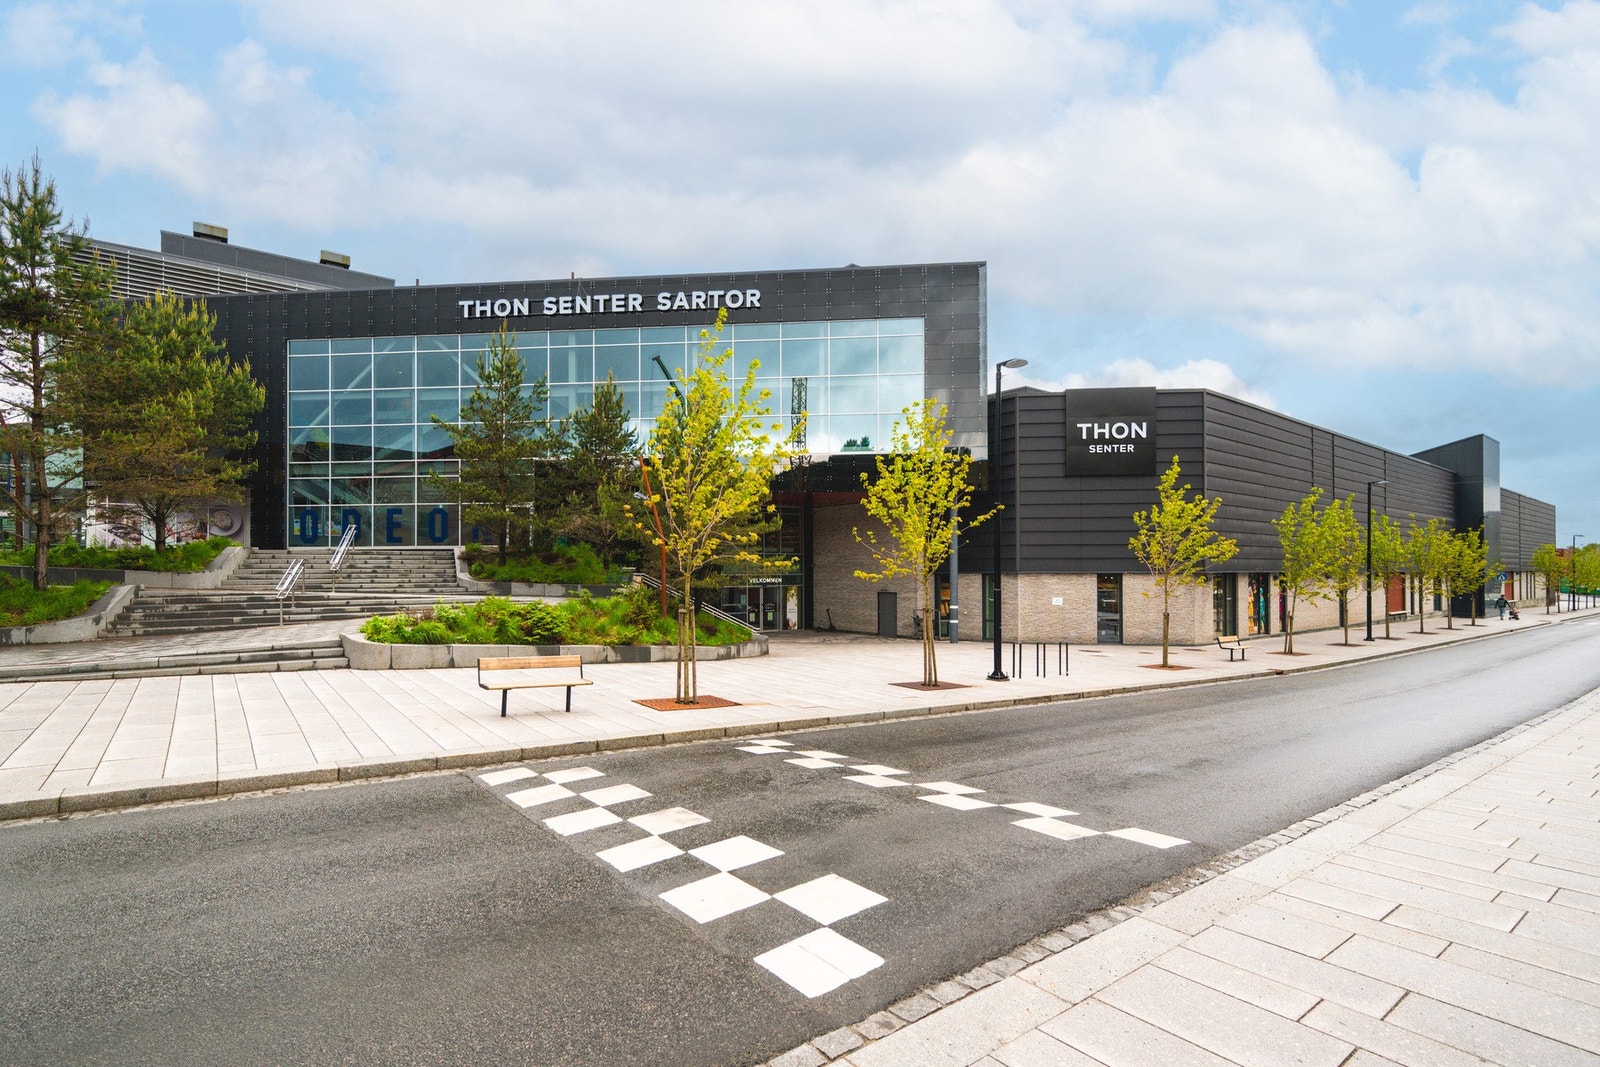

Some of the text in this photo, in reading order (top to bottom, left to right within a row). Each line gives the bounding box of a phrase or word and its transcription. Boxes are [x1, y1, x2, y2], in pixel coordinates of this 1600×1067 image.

[458, 289, 761, 318] THON SENTER SARTOR
[1076, 422, 1147, 440] THON
[1088, 444, 1135, 453] SENTER
